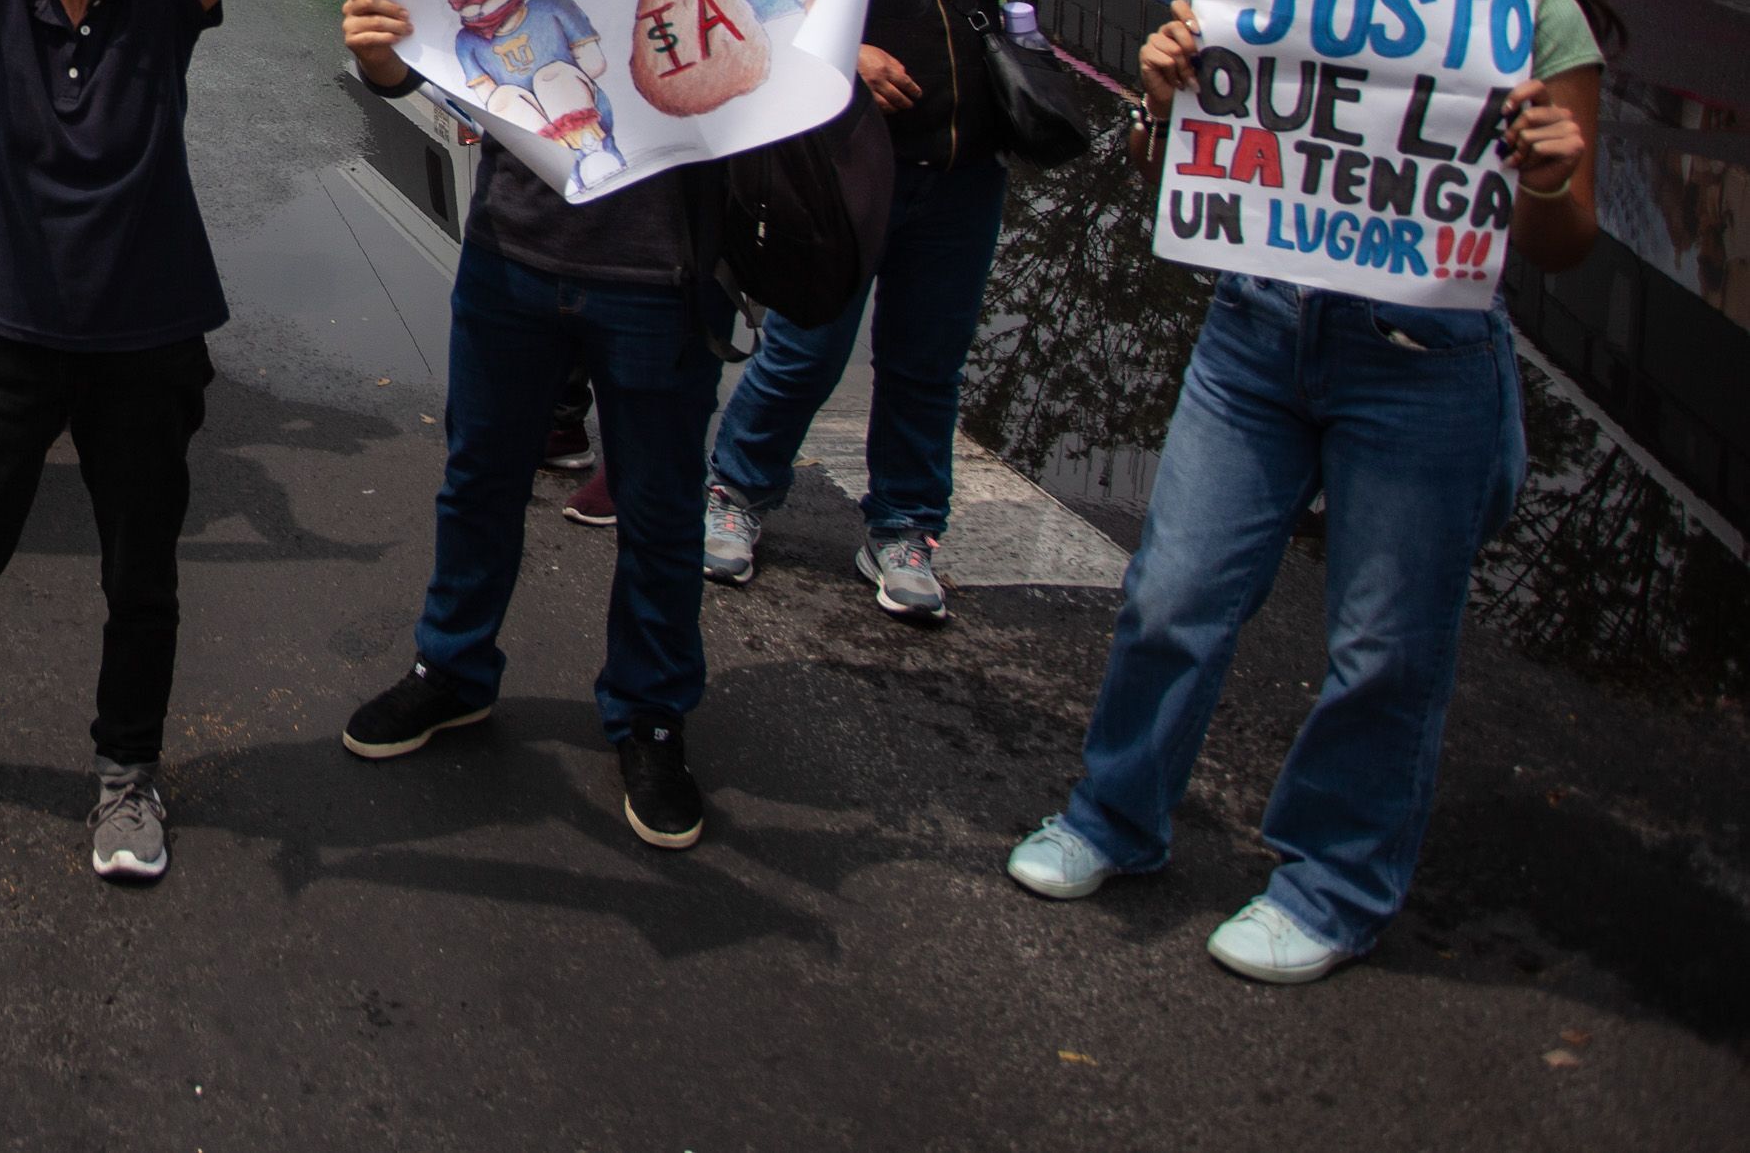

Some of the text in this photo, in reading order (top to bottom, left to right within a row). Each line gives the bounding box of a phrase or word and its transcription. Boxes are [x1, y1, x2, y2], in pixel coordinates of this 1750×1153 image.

[1193, 45, 1515, 165] QUE LA
[1169, 189, 1244, 245] UN
[1176, 118, 1513, 231] IA TENGA
